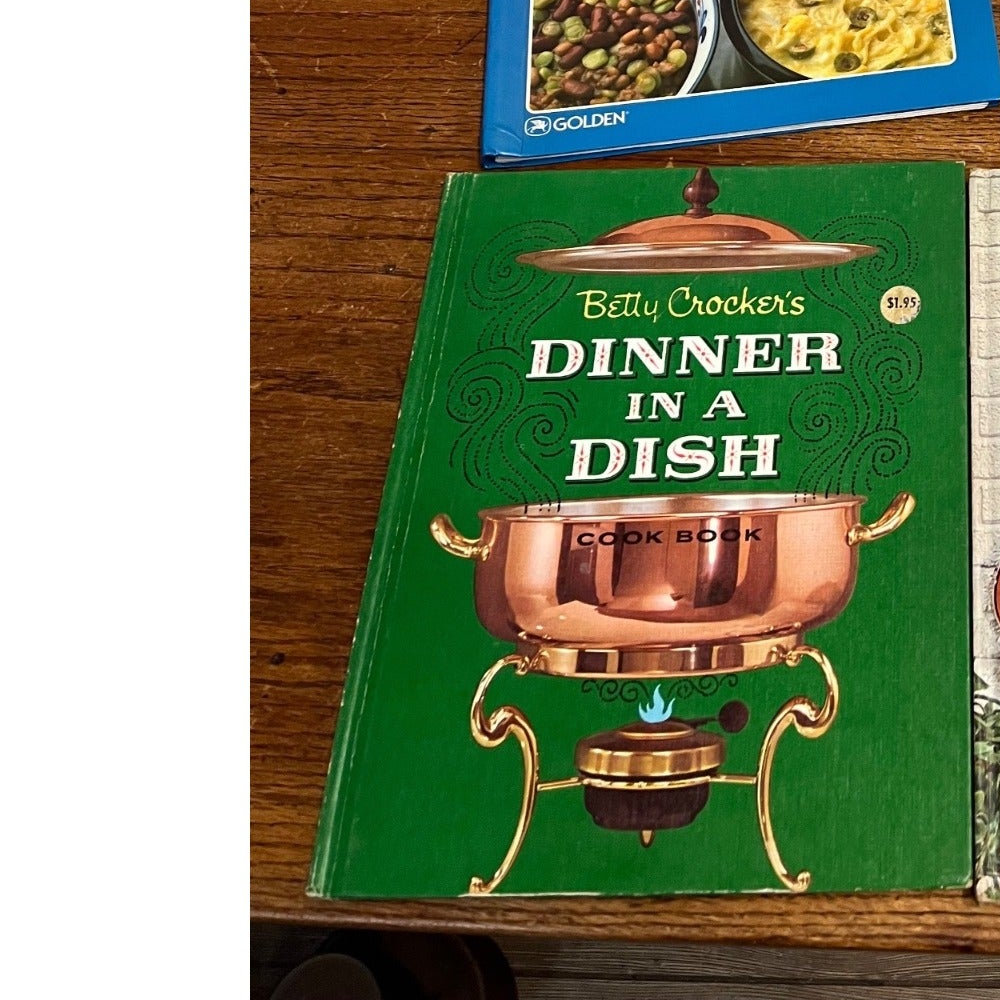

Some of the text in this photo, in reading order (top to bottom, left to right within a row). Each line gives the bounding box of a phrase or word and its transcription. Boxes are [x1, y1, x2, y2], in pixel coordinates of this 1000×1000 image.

[553, 110, 626, 131] GOLDEN
[576, 287, 805, 322] Betty Crocker's
[887, 297, 916, 308] $1.95
[525, 332, 842, 380] DINNER
[625, 390, 746, 420] IN A
[565, 434, 780, 482] DISH
[577, 528, 762, 546] COOK BOOK
